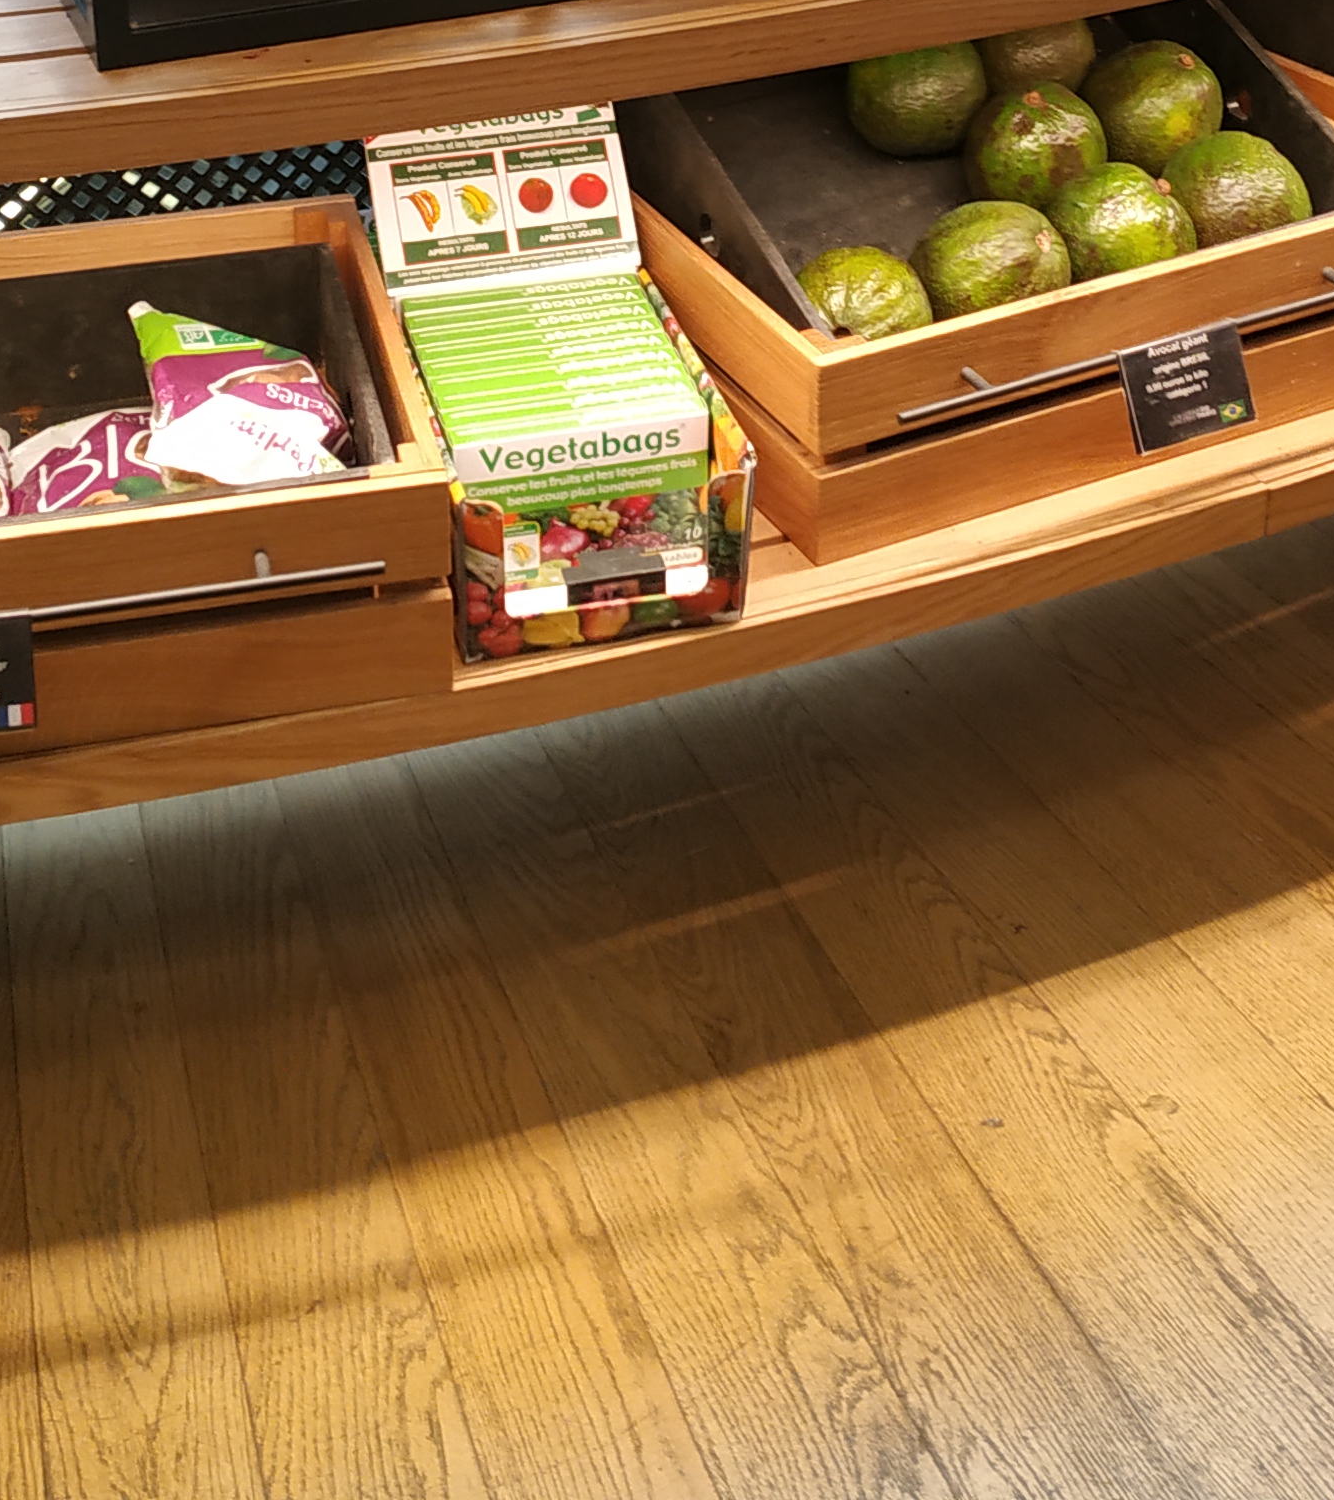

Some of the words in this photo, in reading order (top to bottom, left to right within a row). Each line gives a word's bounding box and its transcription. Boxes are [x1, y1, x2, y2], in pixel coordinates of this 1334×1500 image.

[1147, 340, 1181, 358] Avocat
[478, 428, 681, 473] Vegetabags
[467, 481, 528, 498] Conserve
[528, 477, 547, 490] les
[548, 473, 582, 487] fruits
[581, 470, 596, 483] et
[596, 468, 615, 481] les
[668, 457, 698, 470] frais
[506, 490, 569, 507] beaucoup
[569, 486, 597, 501] plus
[597, 476, 663, 495] longtemps
